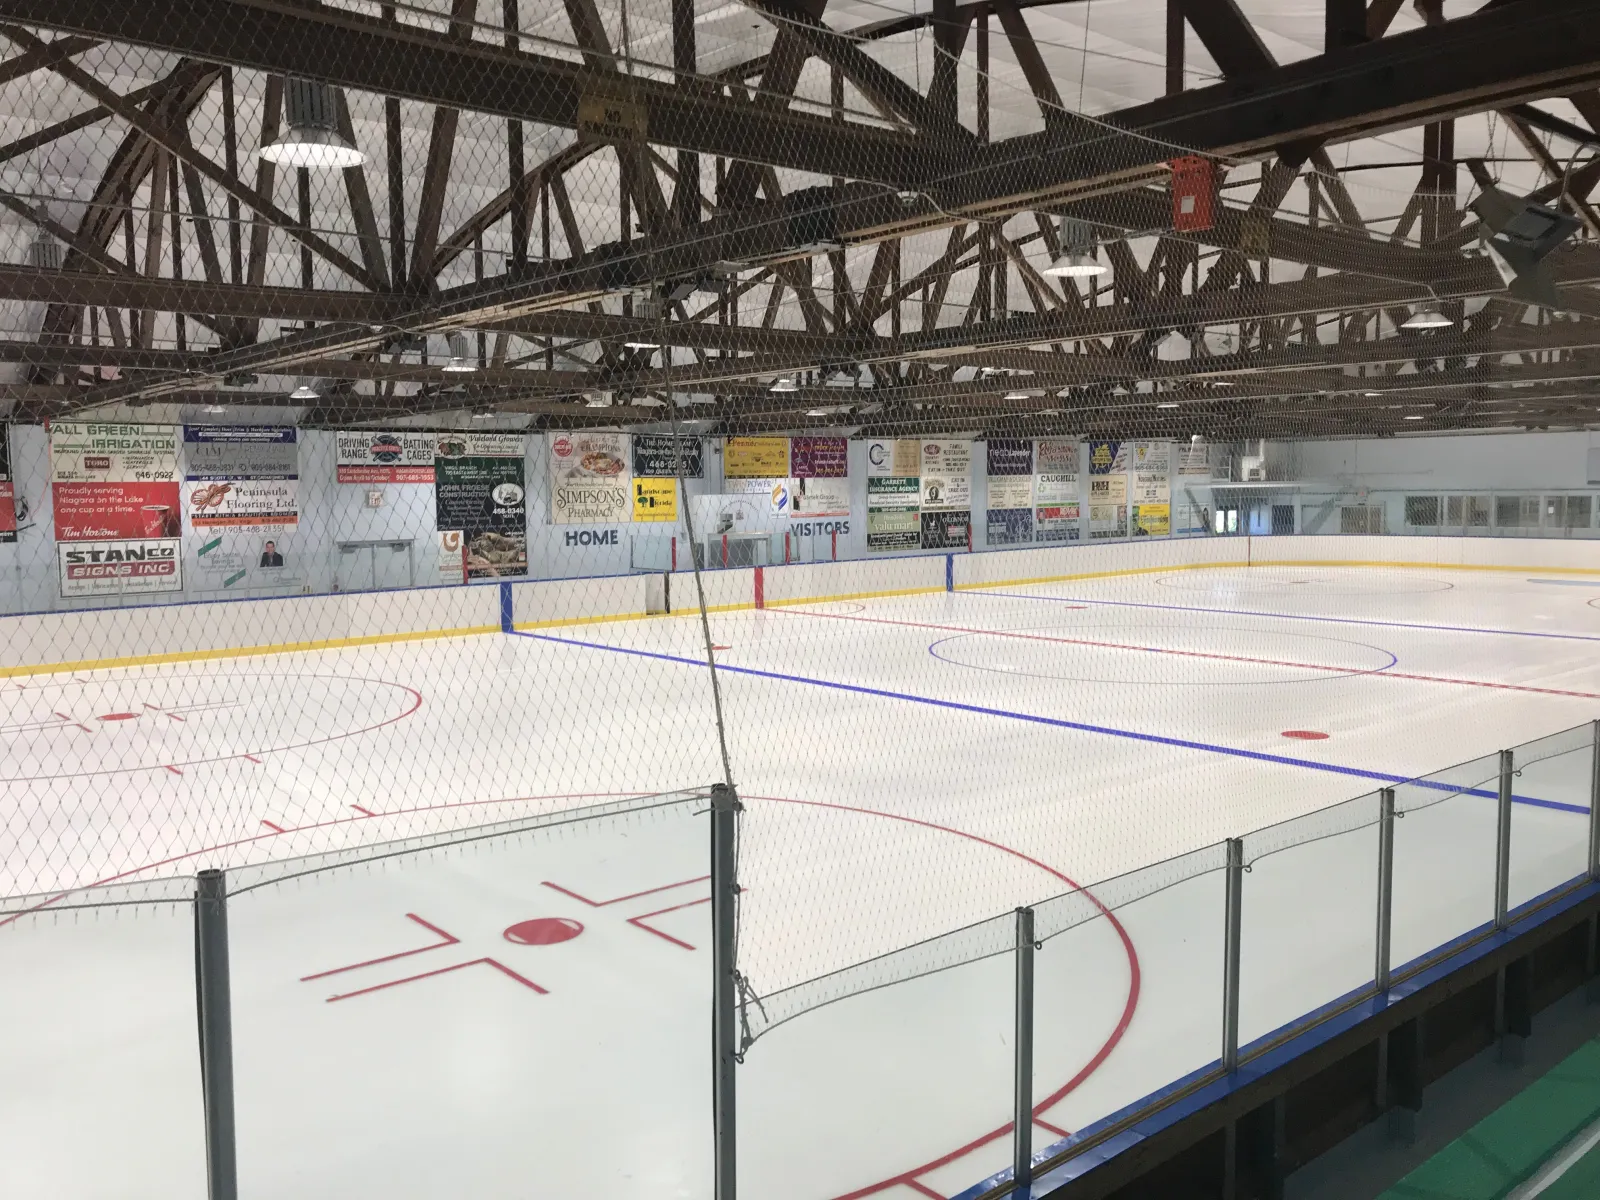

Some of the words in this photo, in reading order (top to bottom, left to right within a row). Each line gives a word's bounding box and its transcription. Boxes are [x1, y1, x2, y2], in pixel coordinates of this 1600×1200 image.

[53, 425, 82, 435] ALL
[87, 425, 139, 435] GREEN
[92, 439, 175, 449] IRRIGATION
[339, 438, 370, 448] DRIVING
[403, 440, 434, 450] BATTING
[341, 449, 369, 459] RANGE
[406, 450, 432, 460] CAGES
[135, 471, 174, 479] 646-0922
[1040, 474, 1076, 482] CAUGHILL
[59, 487, 92, 497] Proudly
[94, 487, 123, 496] serving
[235, 487, 288, 496] Peninsula
[60, 496, 95, 505] Niagara
[227, 499, 273, 510] Flooring
[276, 498, 298, 508] Ltd.
[557, 488, 625, 509] SIMPSON'S
[79, 507, 94, 515] cup
[567, 507, 615, 518] PHARMACY
[61, 526, 81, 538] Tim
[82, 526, 119, 537] Hortons
[790, 521, 850, 537] VISITORS
[565, 530, 619, 546] HOME
[66, 545, 174, 563] STANCO
[73, 566, 132, 577] SIGNS
[138, 564, 170, 574] INC
